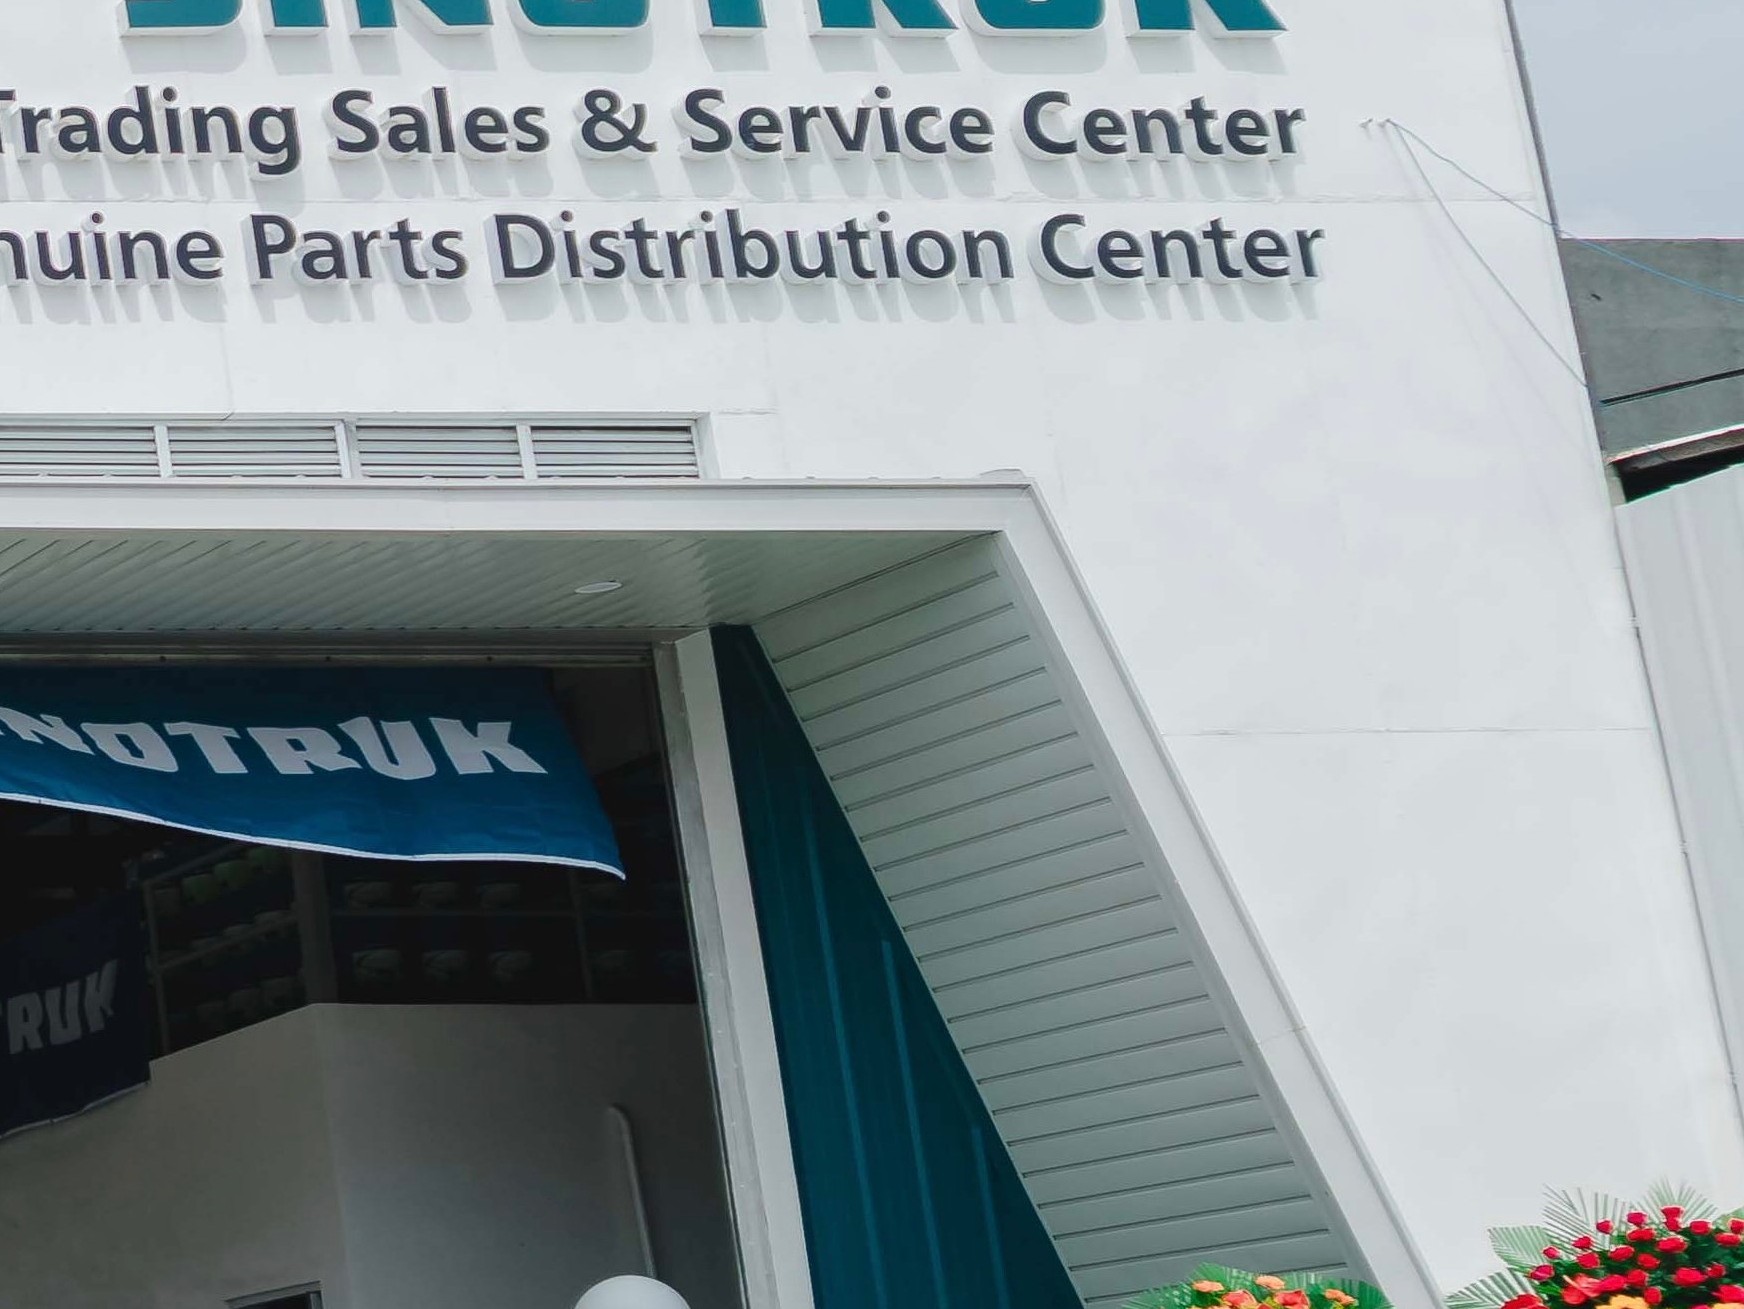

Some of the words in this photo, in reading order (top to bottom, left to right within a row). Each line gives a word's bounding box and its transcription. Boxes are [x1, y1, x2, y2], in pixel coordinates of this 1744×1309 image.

[331, 86, 550, 154] Sales
[580, 88, 656, 154] &
[684, 88, 992, 155] Service
[1022, 90, 1303, 156] Center
[250, 213, 467, 281] Parts
[494, 208, 1012, 280] Distribution
[1040, 213, 1324, 280] Center
